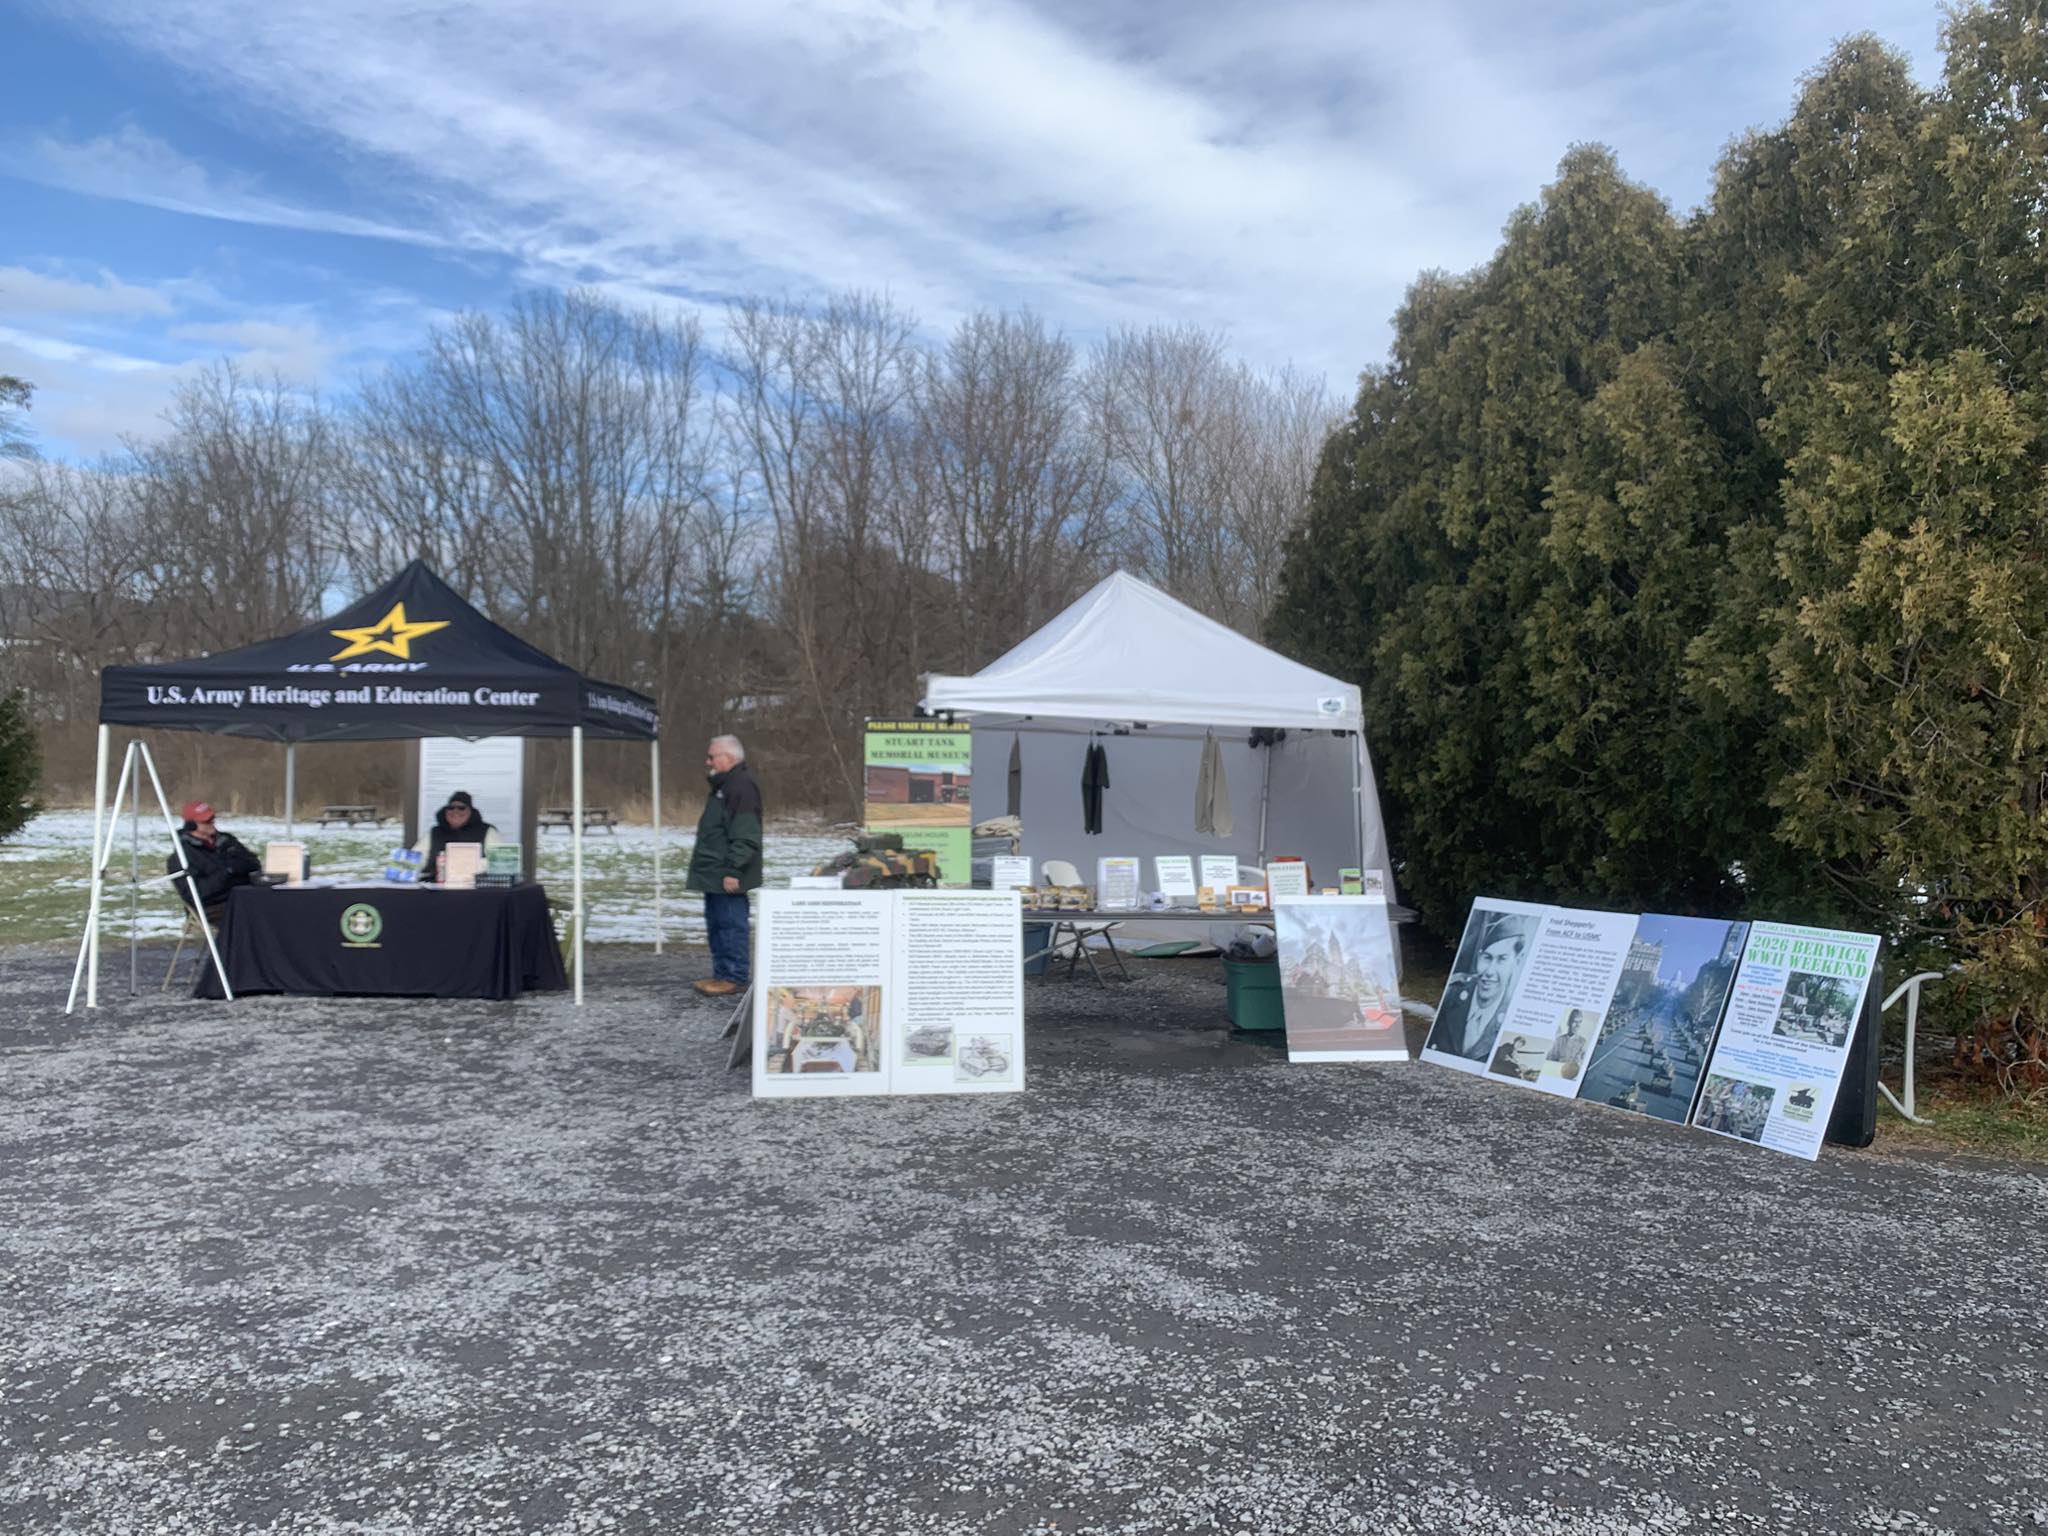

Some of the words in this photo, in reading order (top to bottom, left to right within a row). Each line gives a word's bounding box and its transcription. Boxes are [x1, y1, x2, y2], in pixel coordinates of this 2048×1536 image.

[340, 662, 428, 673] ARMY
[147, 685, 187, 705] U.S.
[190, 686, 245, 708] Army
[249, 685, 331, 708] Heritage
[334, 686, 370, 704] and
[375, 686, 470, 705] Education
[474, 686, 540, 706] Center
[884, 737, 925, 746] STUART
[928, 737, 955, 747] TANK
[870, 750, 923, 760] MEMORIAL
[927, 750, 969, 760] MUSEUM
[1752, 935, 1790, 951] 2026
[1792, 940, 1869, 963] BERWICK
[1747, 948, 1785, 967] WWII
[1789, 953, 1867, 978] WEEKEND
